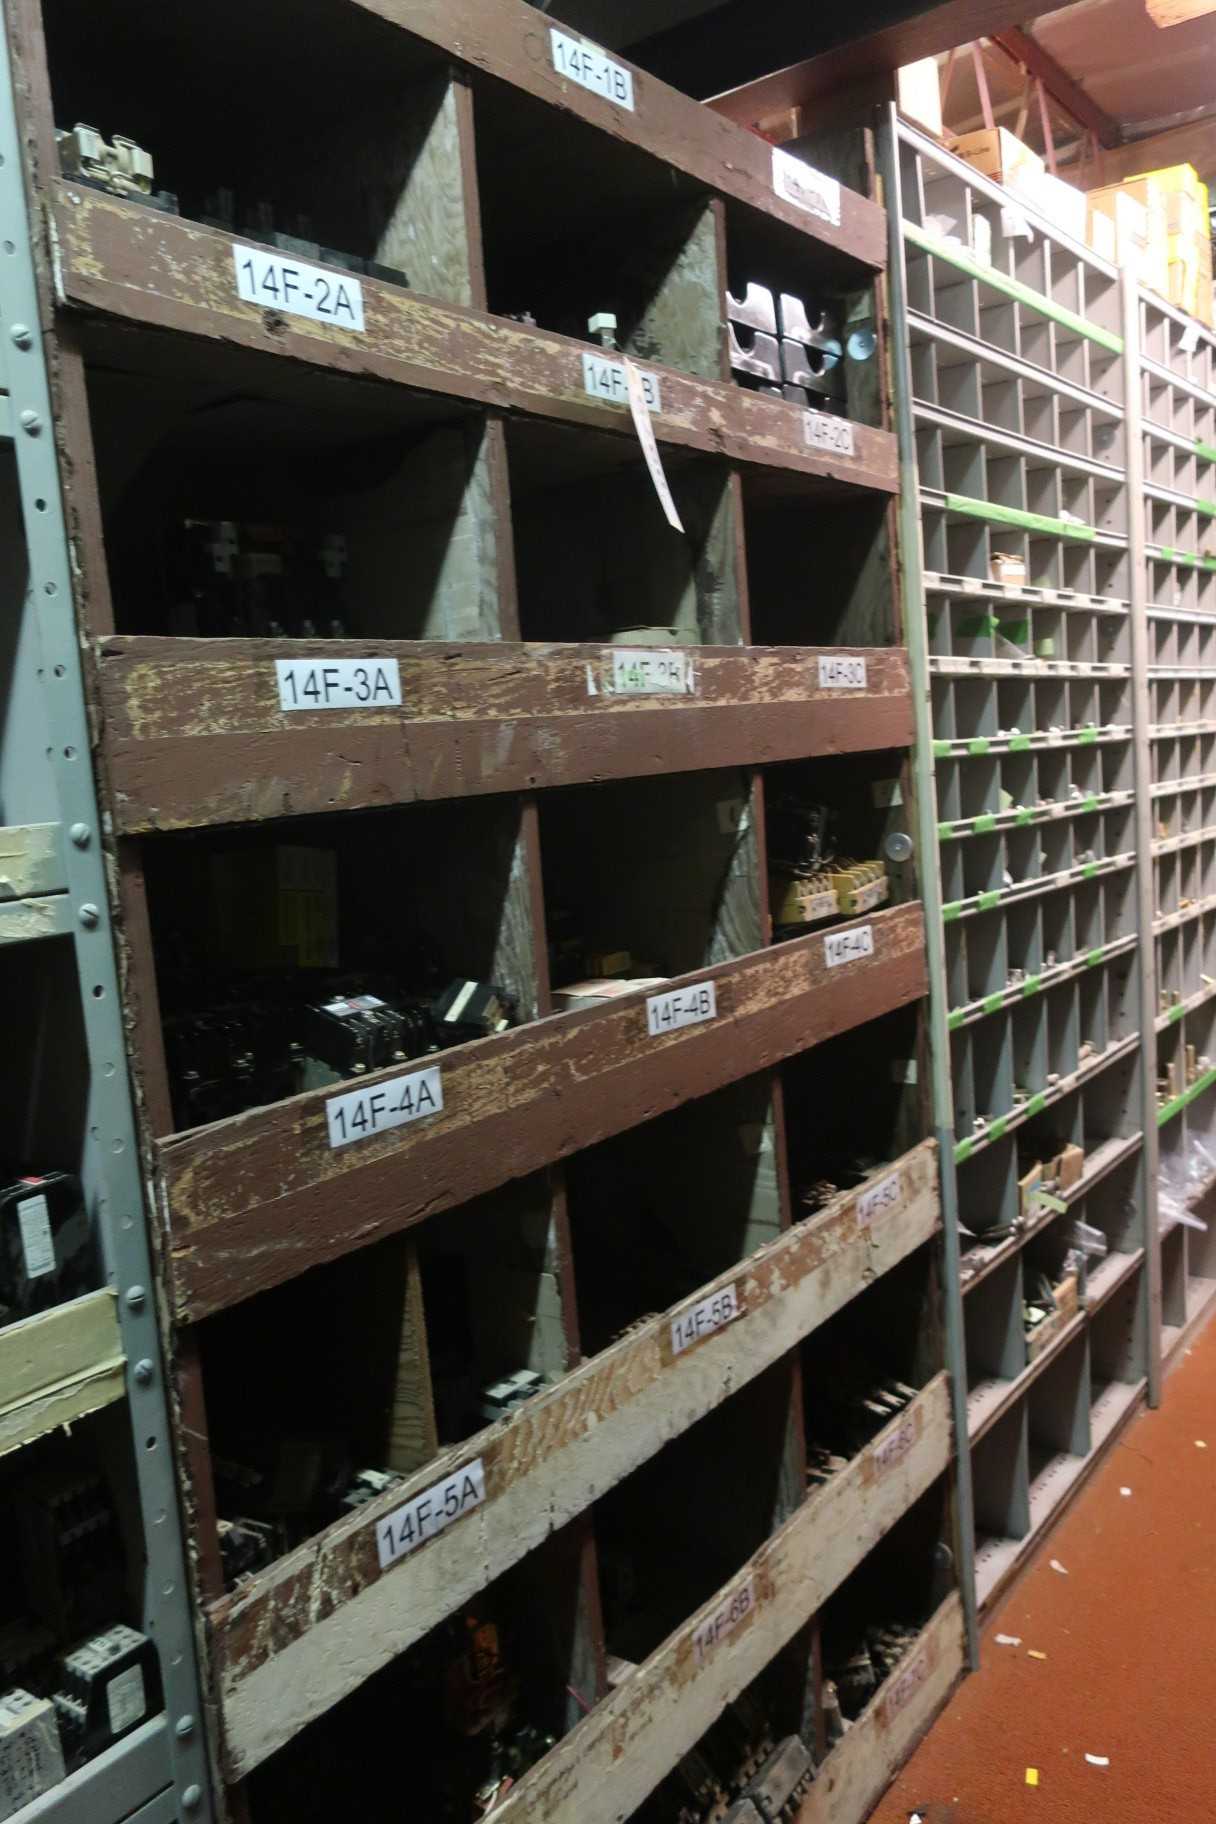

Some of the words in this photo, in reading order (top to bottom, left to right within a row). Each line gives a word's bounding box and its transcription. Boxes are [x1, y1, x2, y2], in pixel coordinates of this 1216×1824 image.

[557, 42, 627, 101] 14F-1B
[242, 259, 356, 321] 14F-2A
[587, 362, 655, 404] 14F-B
[284, 667, 394, 704] 14F-3A
[651, 989, 711, 1029] 14F-4B
[334, 1079, 437, 1139] 14F-4A
[676, 1294, 734, 1347] 14F-5B
[382, 1475, 479, 1556] 14F-5A
